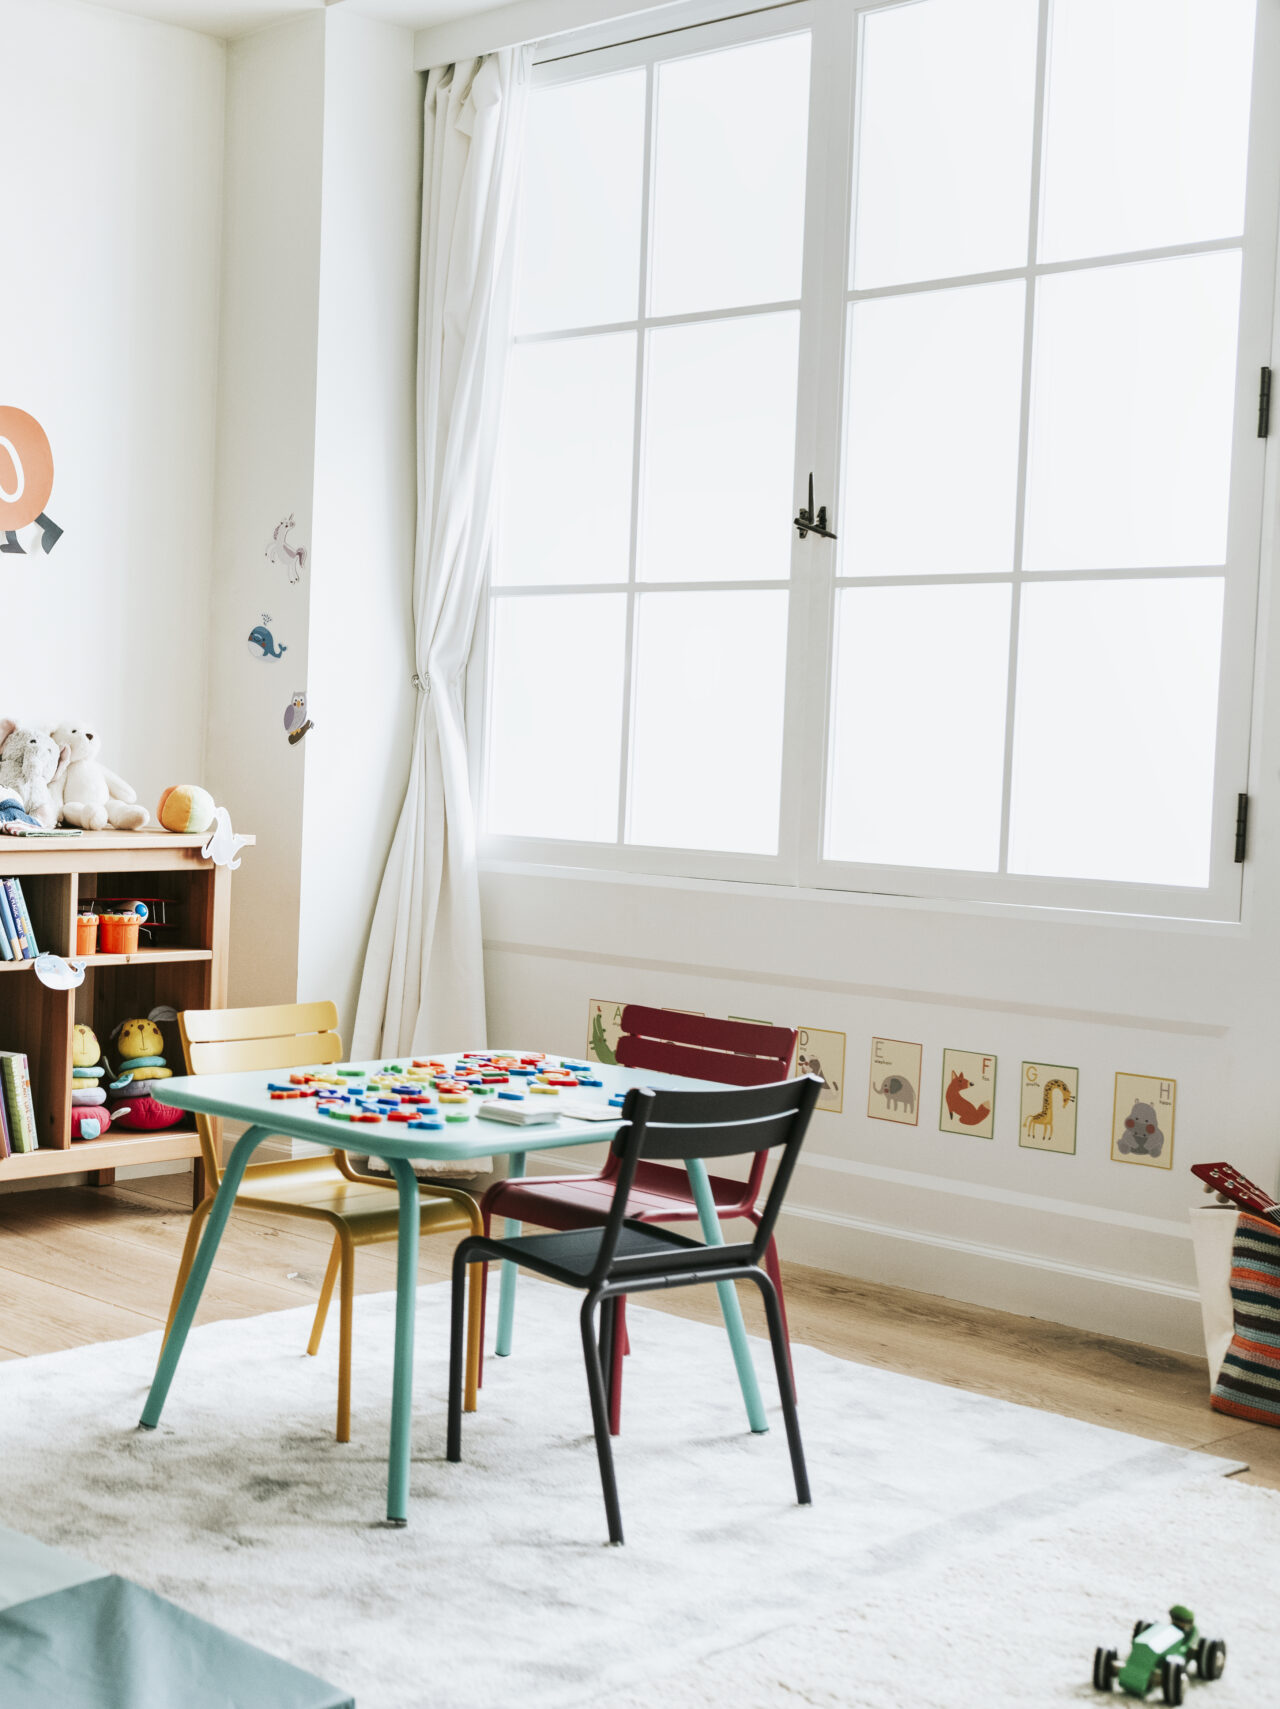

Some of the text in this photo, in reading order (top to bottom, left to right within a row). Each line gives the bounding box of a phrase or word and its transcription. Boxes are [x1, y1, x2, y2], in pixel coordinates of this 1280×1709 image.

[613, 1005, 622, 1021] A
[800, 1030, 809, 1046] D
[875, 1040, 884, 1058] E
[982, 1057, 992, 1074] F
[1025, 1065, 1038, 1082] G
[1159, 1081, 1171, 1100] H
